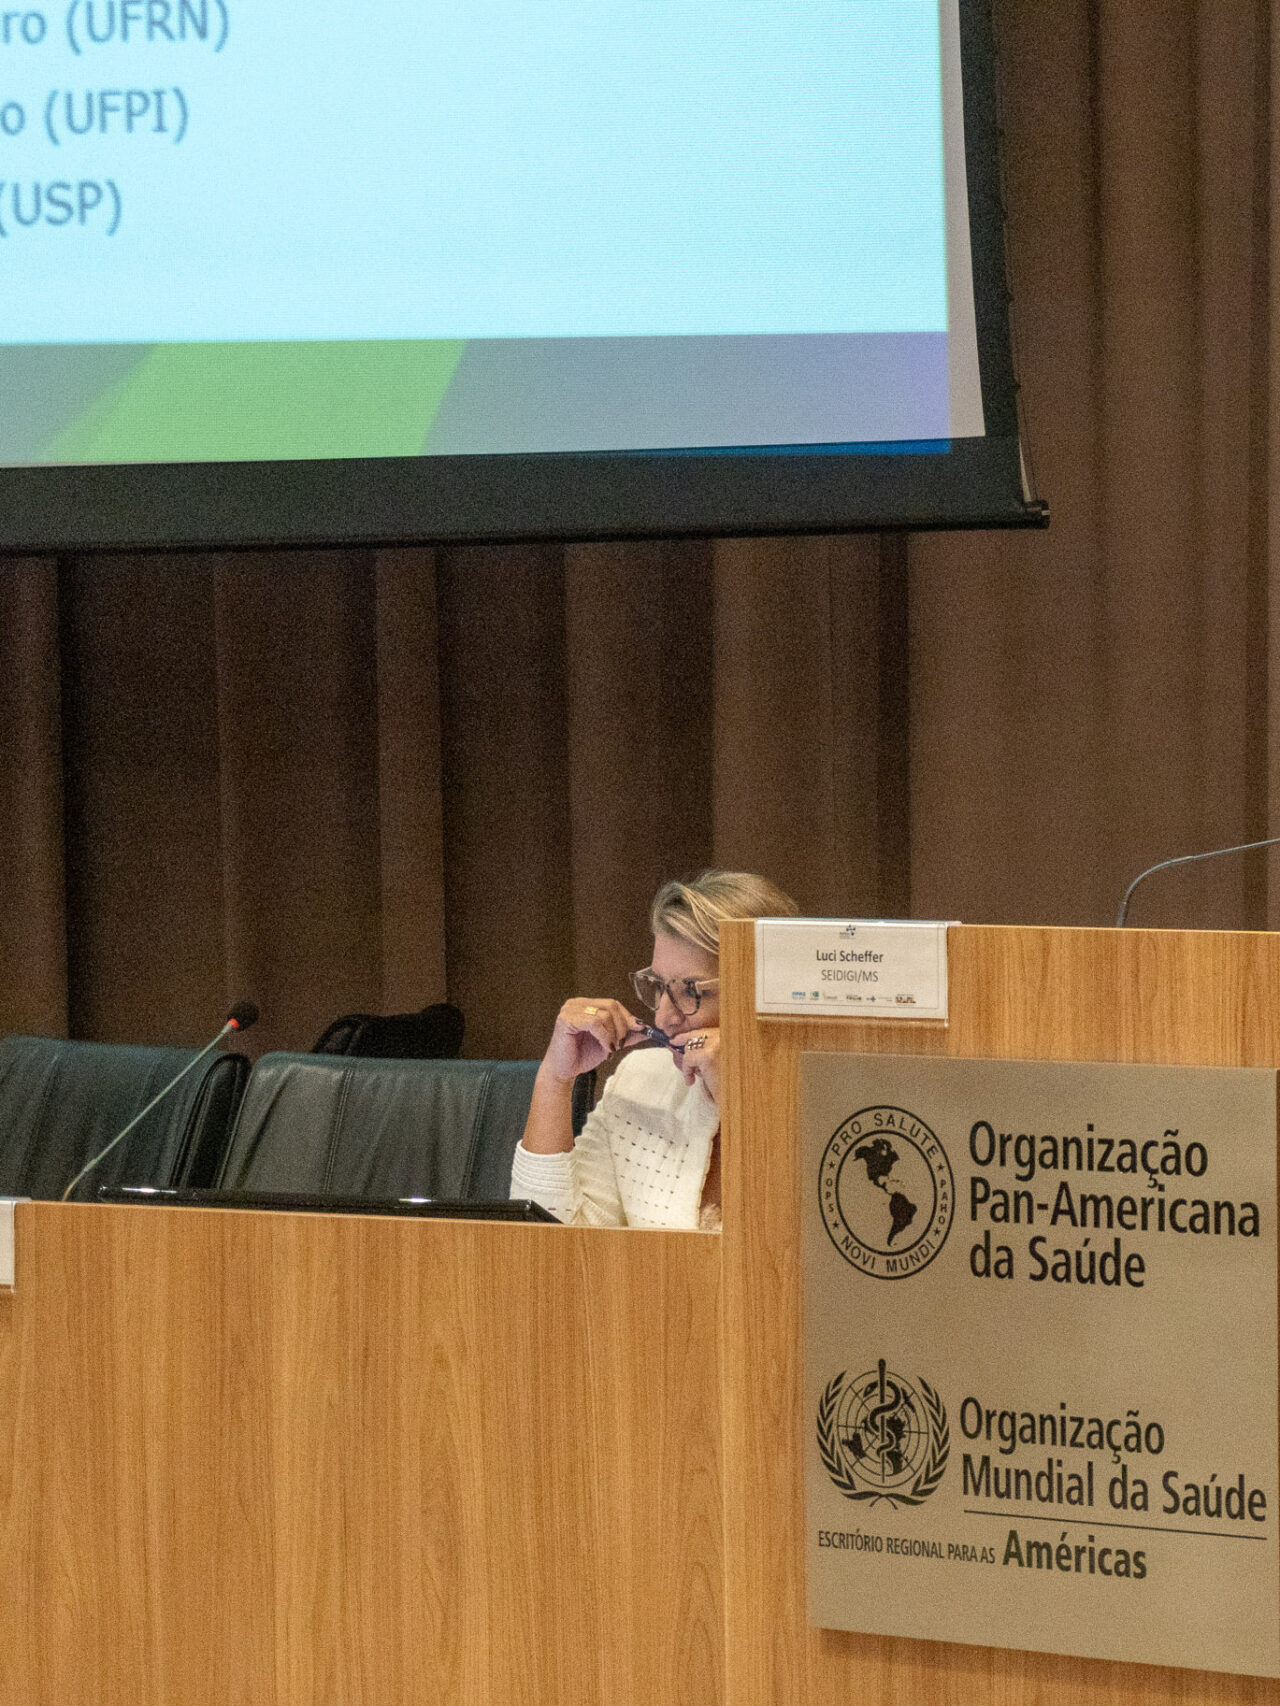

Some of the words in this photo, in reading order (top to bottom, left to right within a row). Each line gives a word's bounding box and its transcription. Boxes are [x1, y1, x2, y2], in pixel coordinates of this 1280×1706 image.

[66, 0, 230, 56] (UFRN)
[45, 86, 188, 146] (UFPI)
[816, 949, 837, 962] Luci
[840, 950, 884, 963] Scheffer
[821, 968, 879, 984] SEIDIGI/MS
[831, 1120, 862, 1156] PRO
[873, 1112, 939, 1159] SALUTE
[969, 1119, 1209, 1189] Organização
[825, 1177, 834, 1213] OPS
[938, 1179, 948, 1225] PAHO
[970, 1175, 1261, 1238] Pan-Americana
[841, 1235, 876, 1270] NOVI
[885, 1239, 936, 1273] MUNDI
[969, 1230, 1014, 1280] da
[1028, 1234, 1146, 1288] Saúde
[959, 1396, 1165, 1463] Organização
[961, 1453, 1095, 1507] Mundial
[1108, 1464, 1149, 1512] da
[1162, 1470, 1267, 1522] Saúde
[818, 1528, 883, 1553] ESCRITÓRIO
[886, 1537, 945, 1559] REGIONAL
[947, 1543, 978, 1563] PARA
[979, 1547, 996, 1564] AS
[1002, 1529, 1147, 1580] Américas
